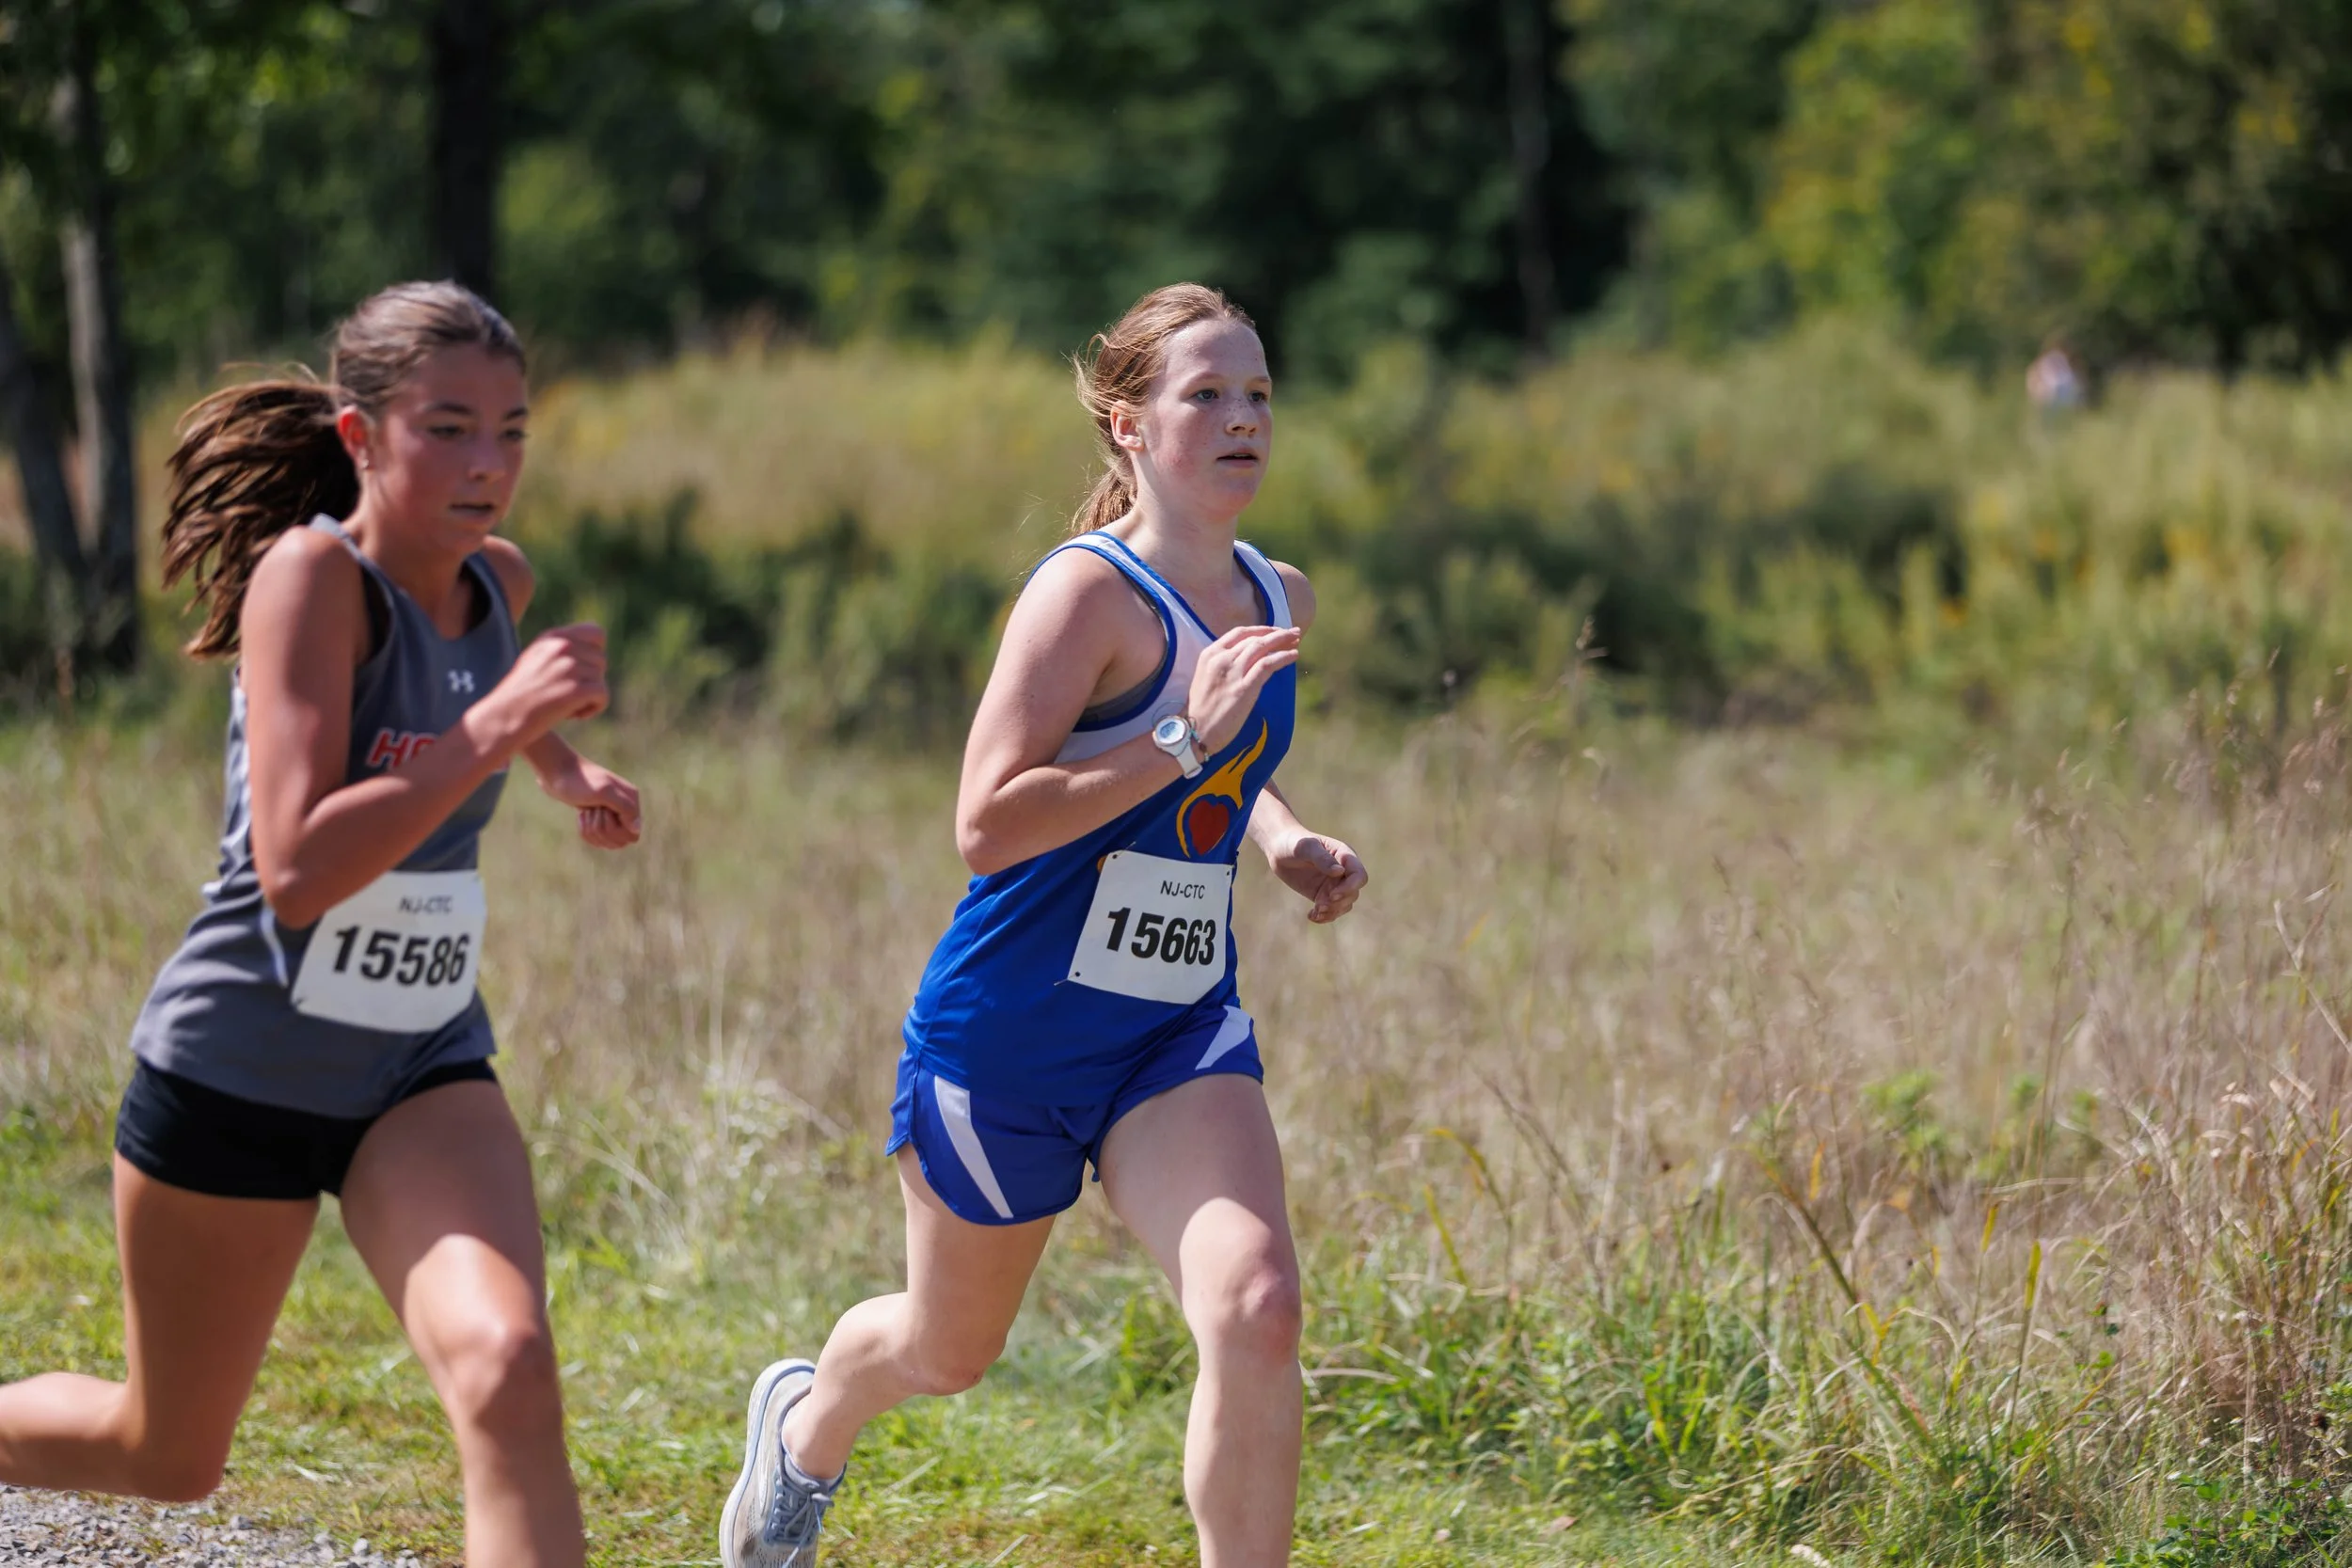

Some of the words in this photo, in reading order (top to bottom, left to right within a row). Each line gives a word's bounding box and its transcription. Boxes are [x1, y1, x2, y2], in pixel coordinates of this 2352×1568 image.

[399, 895, 453, 913] NJ-CTC
[1160, 880, 1205, 899] NJ-CTC
[332, 925, 470, 987] 15586
[1106, 907, 1216, 966] 15663
